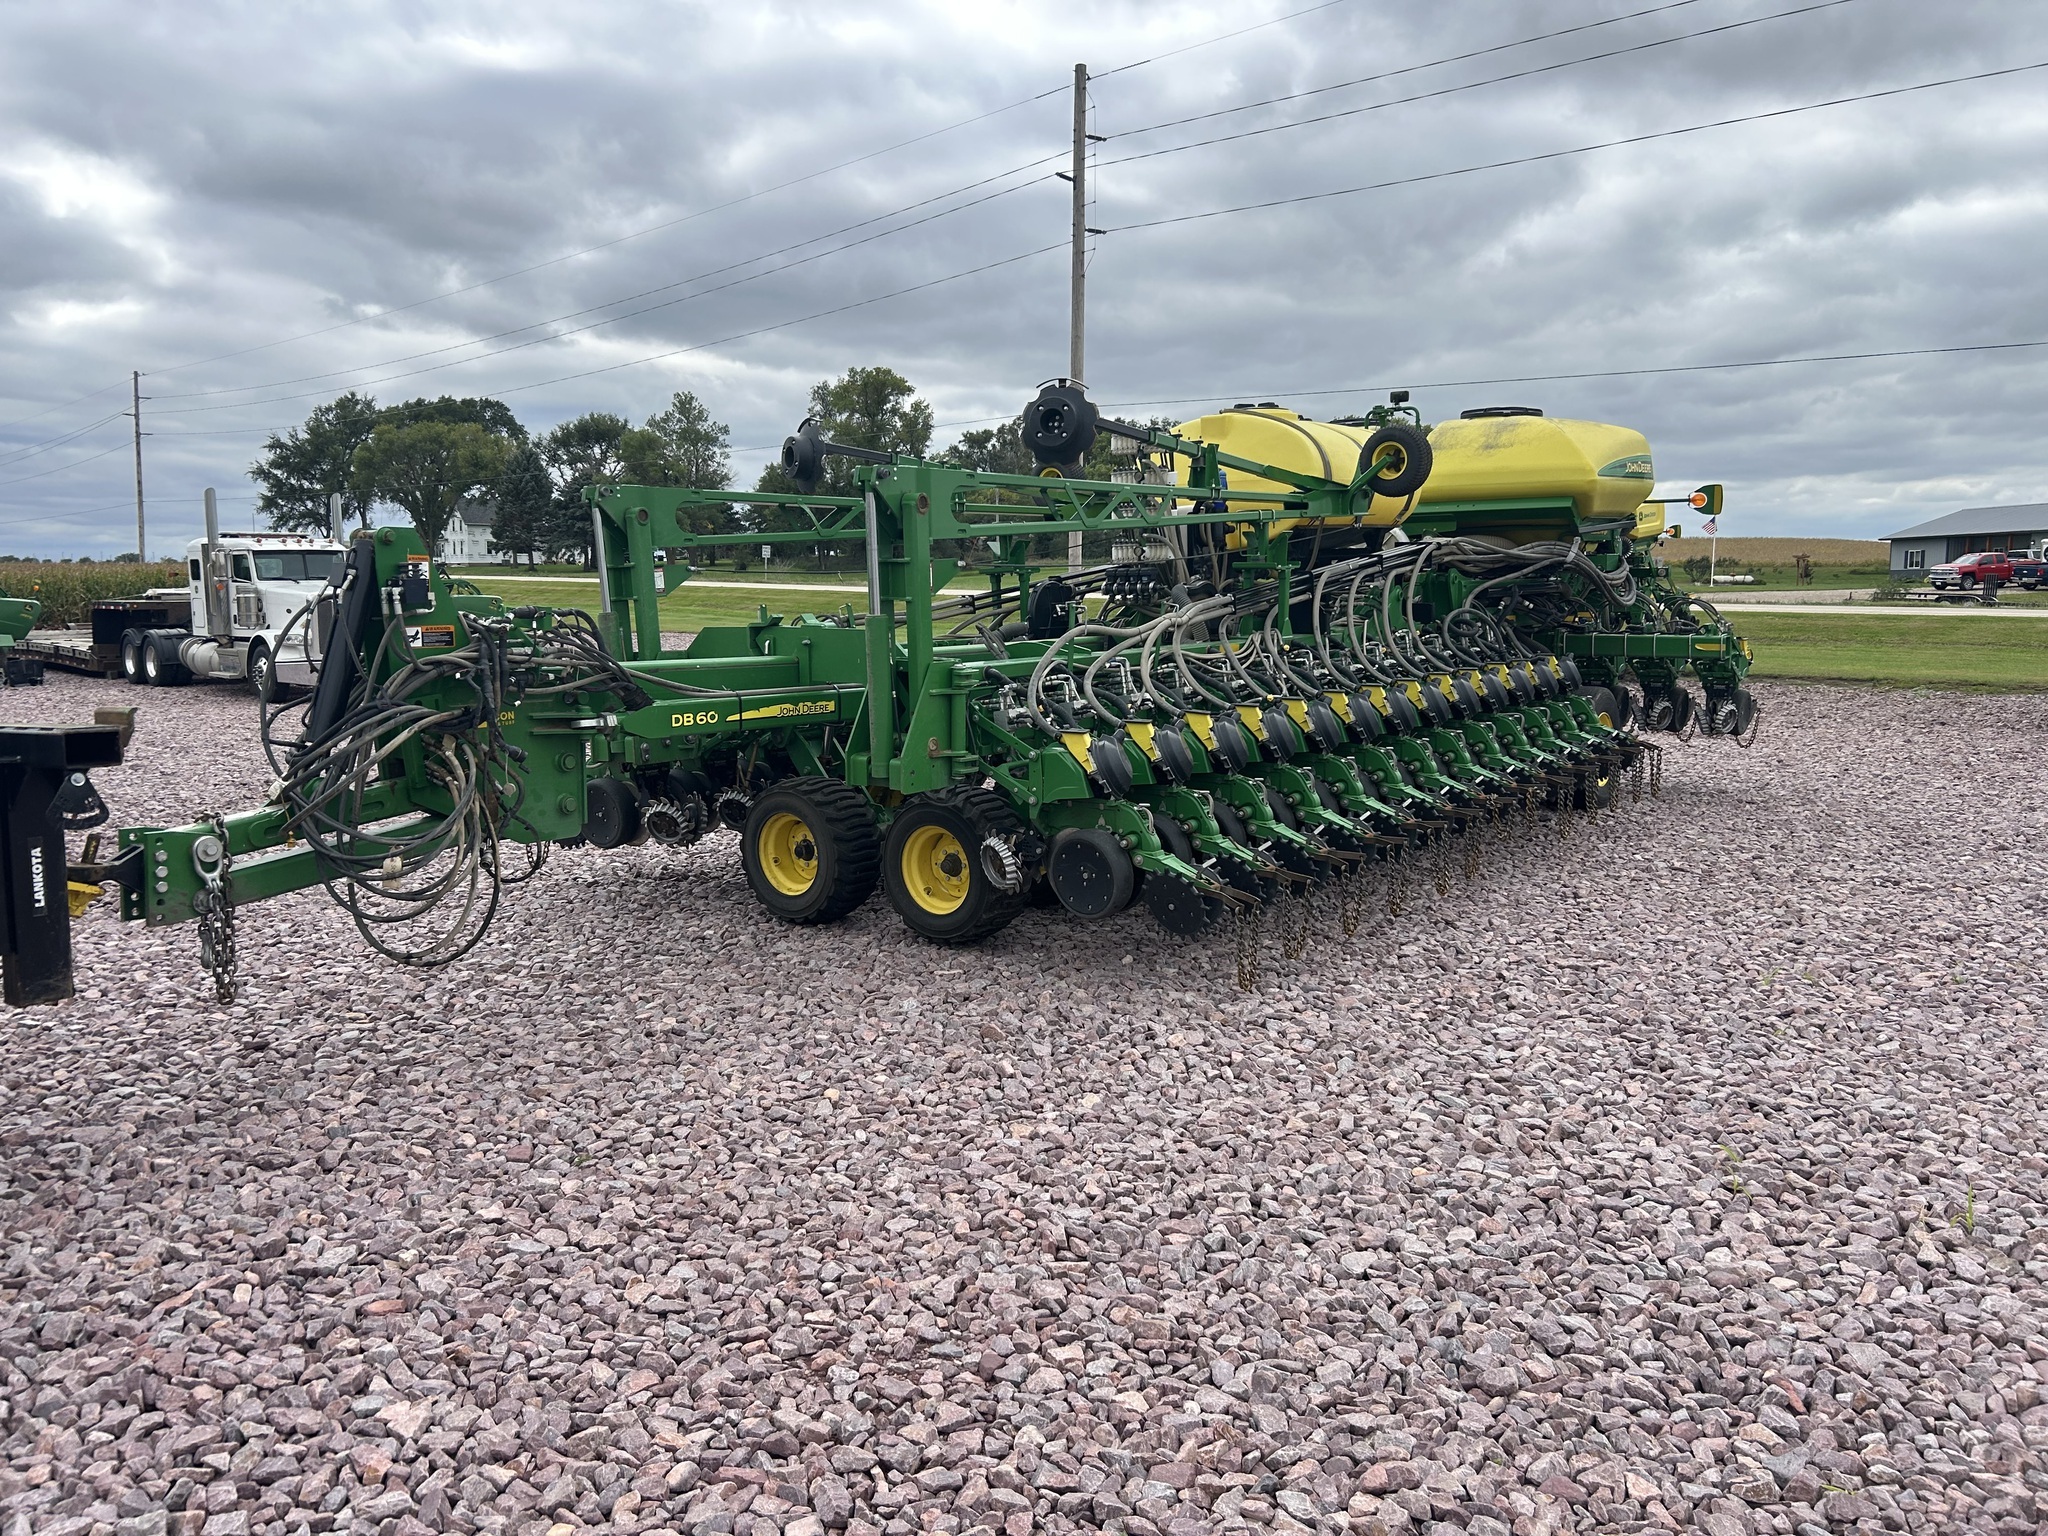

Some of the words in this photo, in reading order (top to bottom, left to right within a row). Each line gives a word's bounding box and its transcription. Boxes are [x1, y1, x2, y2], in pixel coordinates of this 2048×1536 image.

[1625, 461, 1638, 472] JOHN
[1638, 461, 1651, 472] DEERE
[777, 706, 801, 716] JOHN
[802, 703, 830, 714] DEERE
[30, 847, 46, 908] LANKOTA
